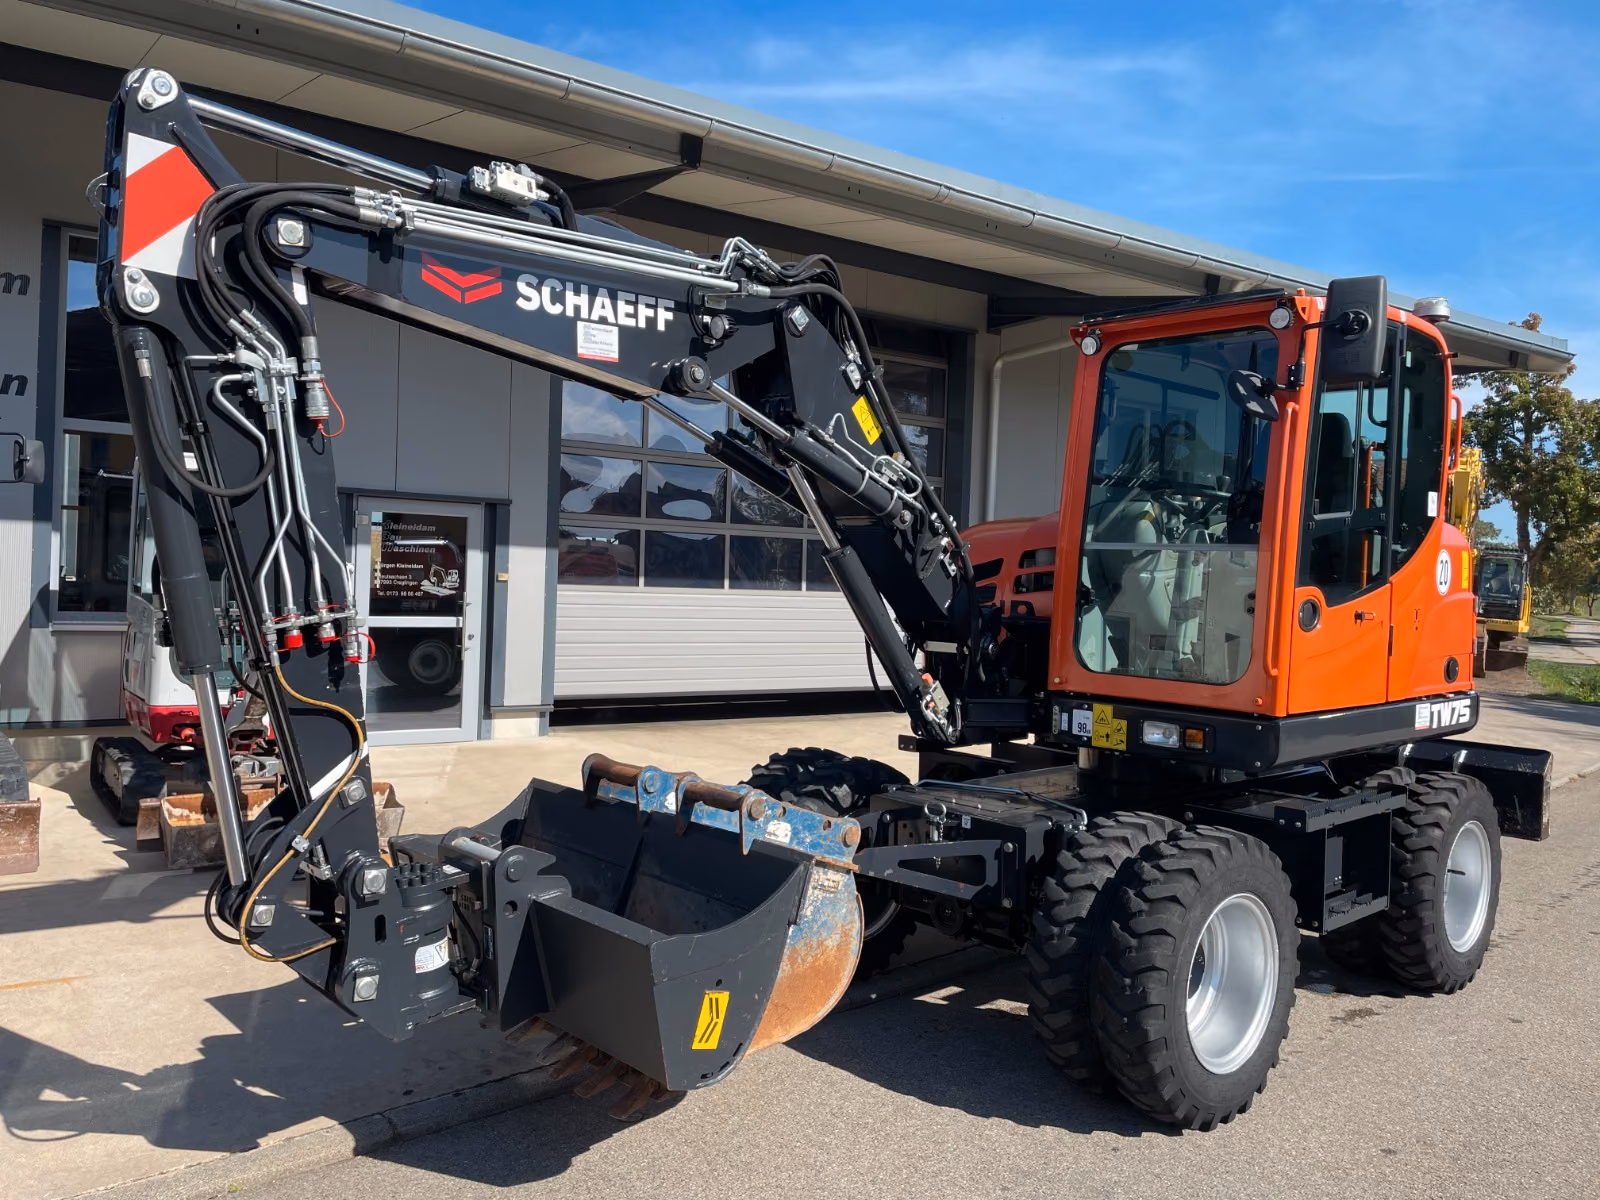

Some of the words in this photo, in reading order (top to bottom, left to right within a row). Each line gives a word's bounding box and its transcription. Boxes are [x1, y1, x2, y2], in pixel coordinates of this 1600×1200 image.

[516, 274, 675, 331] SCHAEFF
[1439, 559, 1449, 586] 20
[1077, 722, 1087, 733] 98
[1431, 698, 1471, 729] TW75
